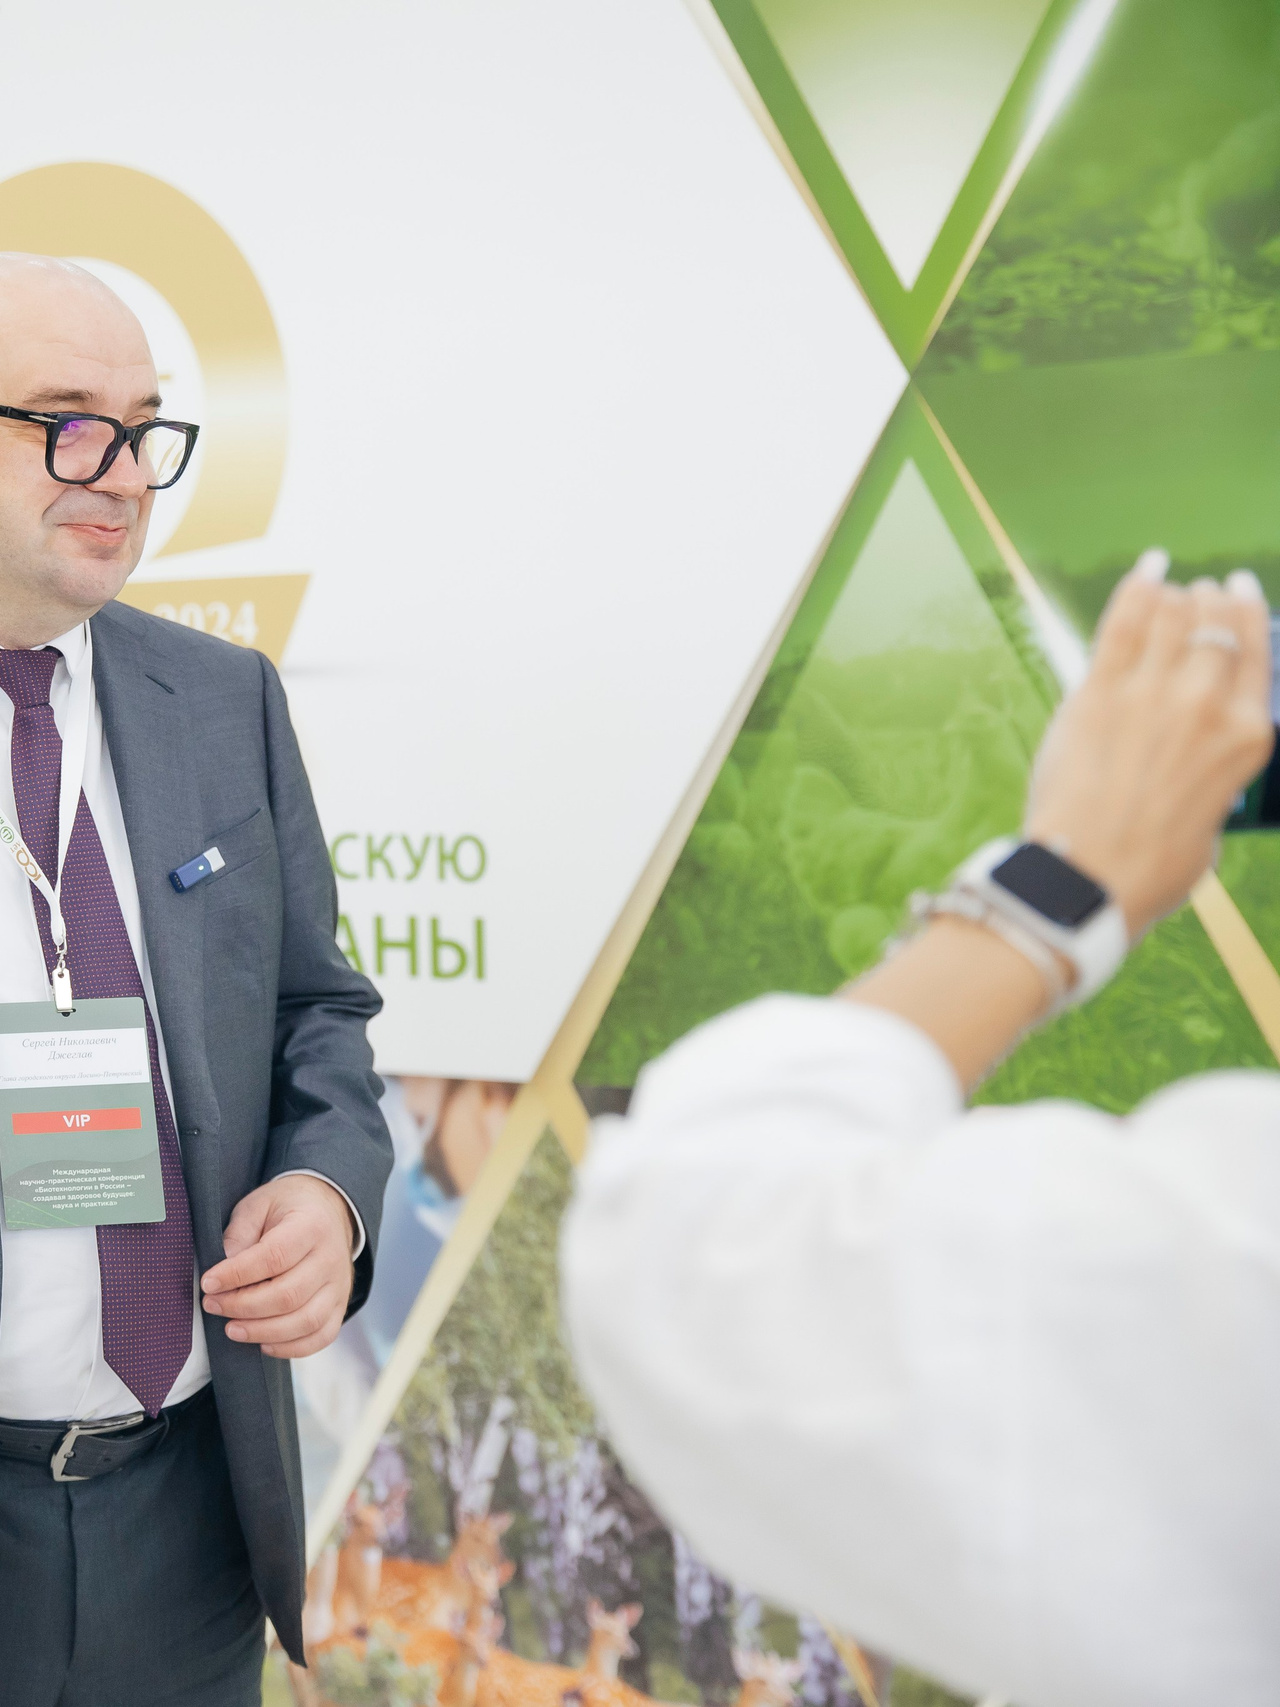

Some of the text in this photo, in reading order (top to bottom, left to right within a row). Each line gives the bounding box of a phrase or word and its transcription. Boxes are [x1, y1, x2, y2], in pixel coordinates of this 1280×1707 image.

[21, 1037, 117, 1049] Сергей Николаевич
[63, 1114, 91, 1128] VIP
[52, 1167, 111, 1176] Международная
[19, 1174, 145, 1187] научно-практическая конференция
[35, 1185, 93, 1193] «Биотехнологии
[81, 1201, 118, 1209] практика»
